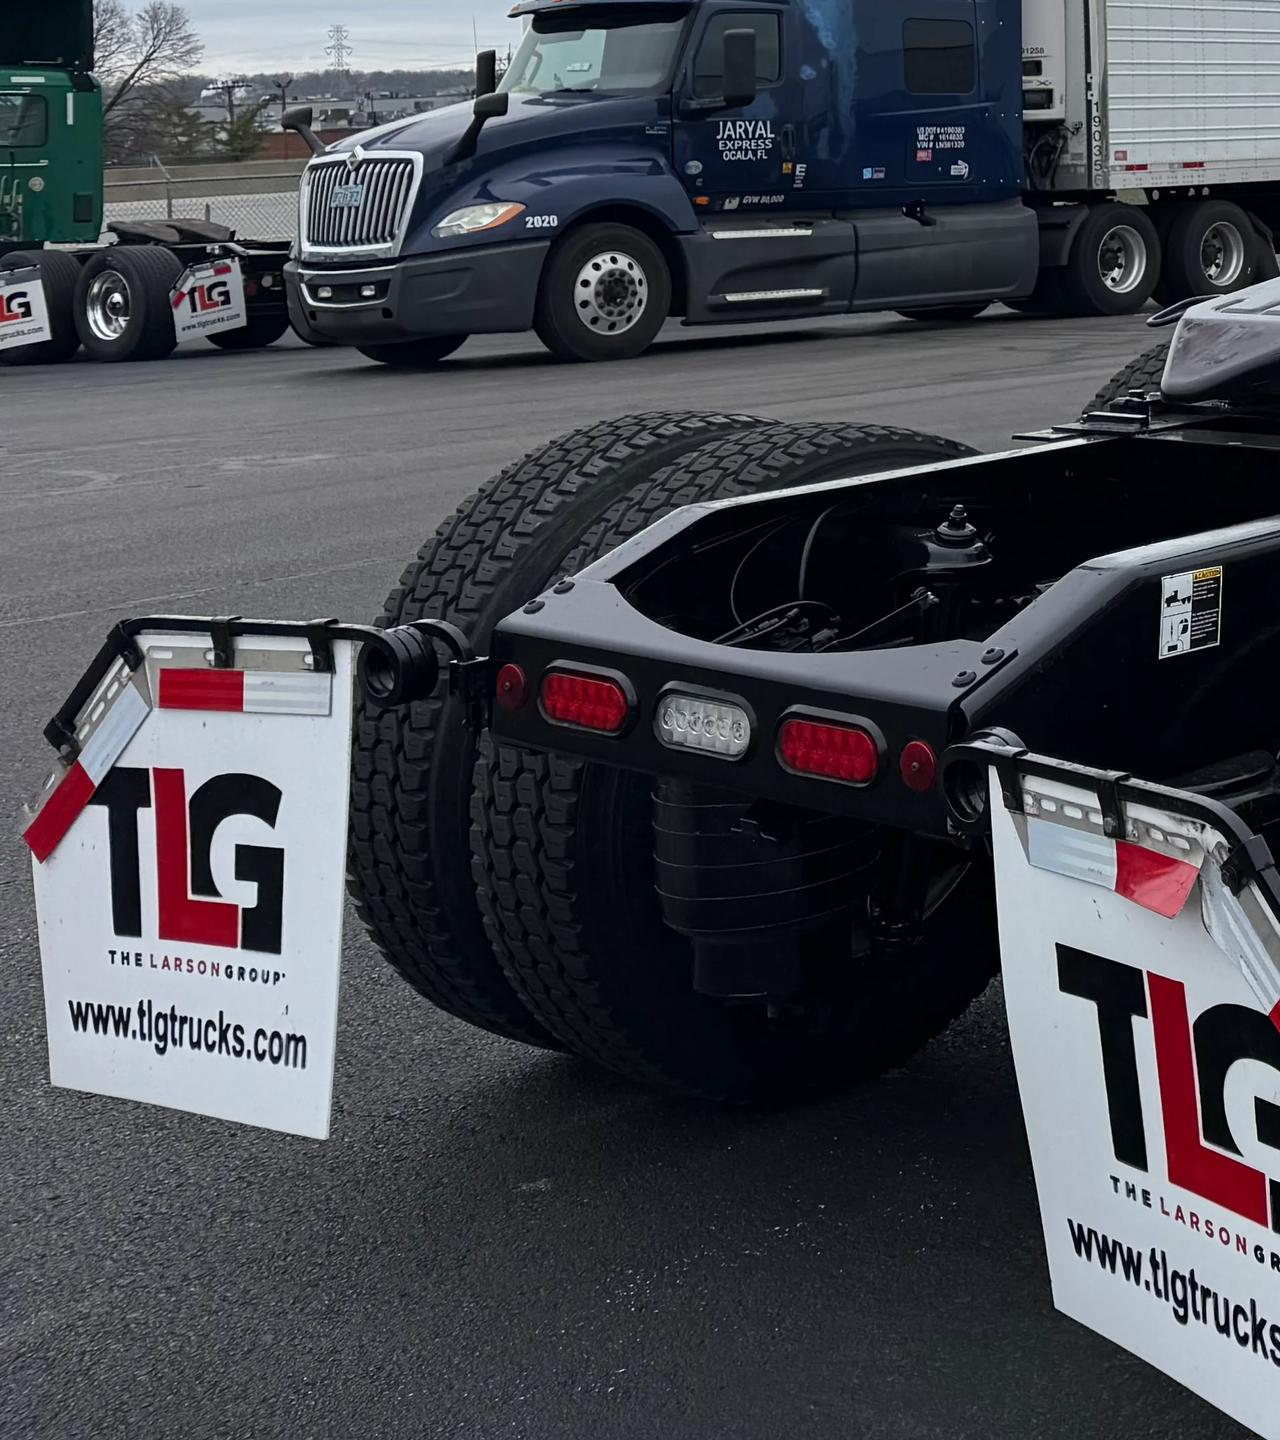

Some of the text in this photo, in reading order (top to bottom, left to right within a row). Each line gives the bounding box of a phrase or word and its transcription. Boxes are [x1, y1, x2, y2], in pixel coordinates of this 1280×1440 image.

[716, 120, 775, 139] JARYAL
[719, 139, 772, 150] EXPRESS
[723, 150, 768, 161] OCALA, FL
[525, 215, 558, 228] 2020
[0, 291, 32, 323] LG
[187, 281, 231, 313] TLG
[87, 766, 285, 955] TLG
[108, 949, 281, 986] THE LARSON GROUP
[67, 998, 308, 1070] www.tlgtrucks.com
[1109, 1174, 1153, 1207] THE
[1160, 1196, 1248, 1254] LARSON
